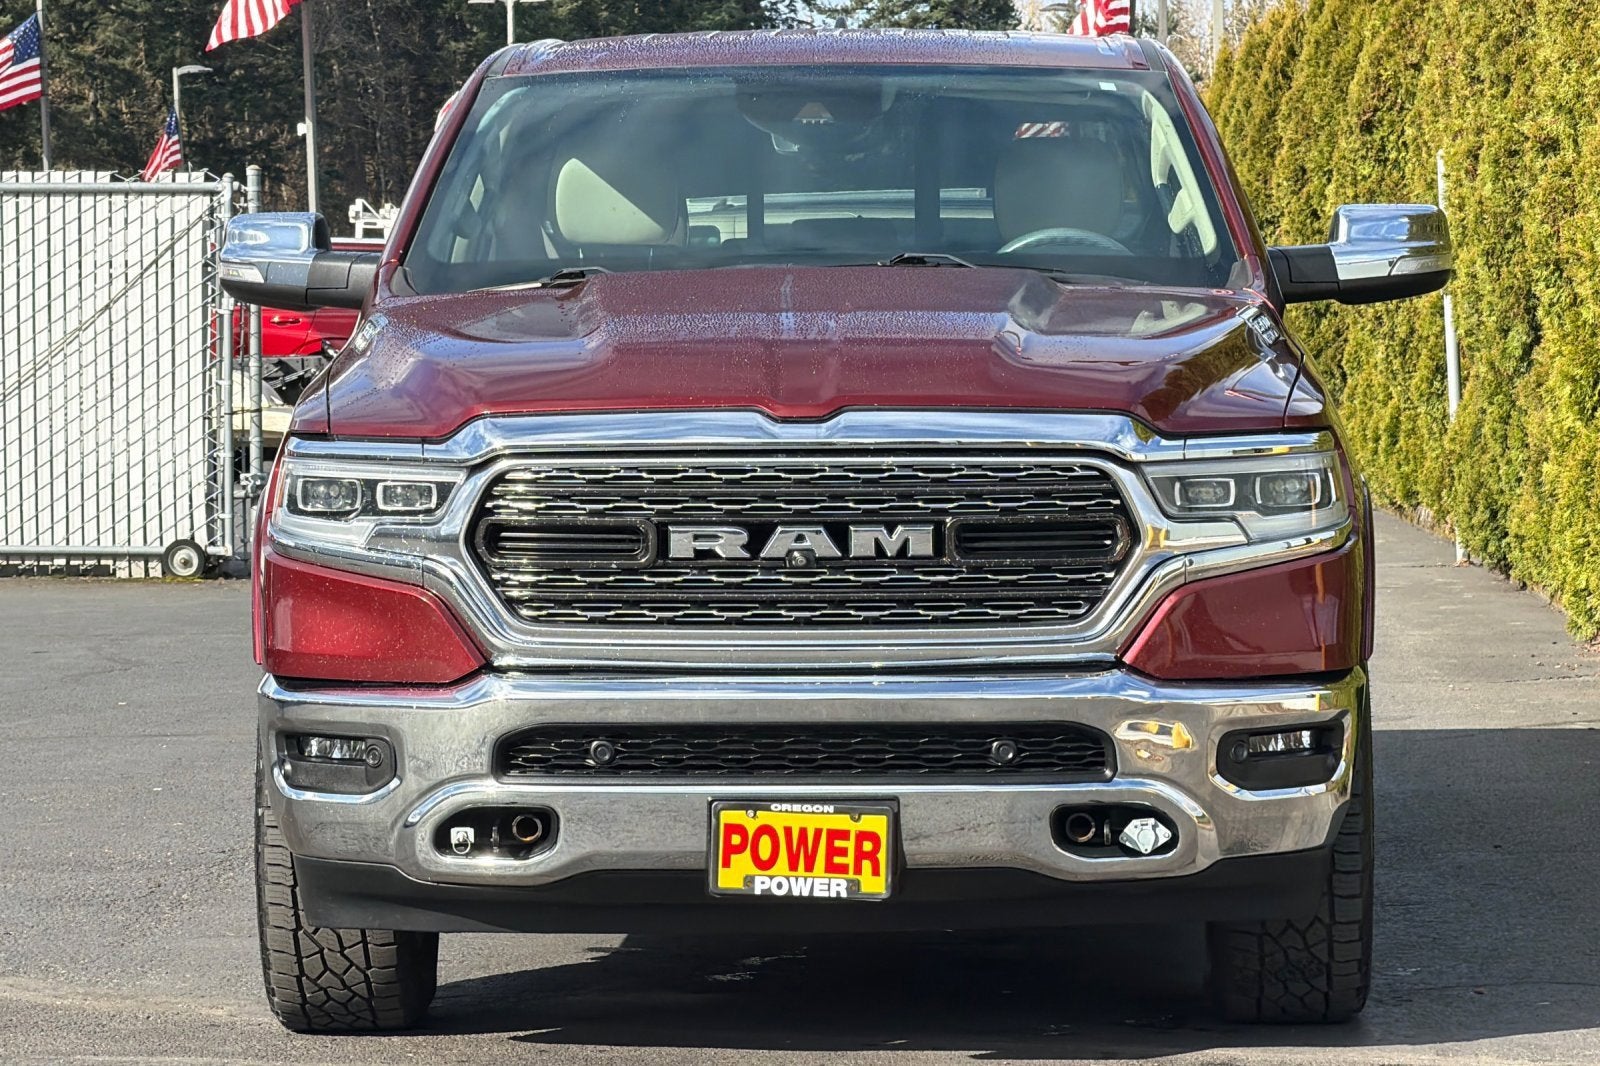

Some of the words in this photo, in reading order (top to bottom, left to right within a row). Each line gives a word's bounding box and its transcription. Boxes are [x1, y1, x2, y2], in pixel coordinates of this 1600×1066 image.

[668, 525, 934, 558] RAM
[770, 803, 834, 813] OREGON
[721, 822, 882, 877] POWER
[754, 875, 848, 897] POWER
